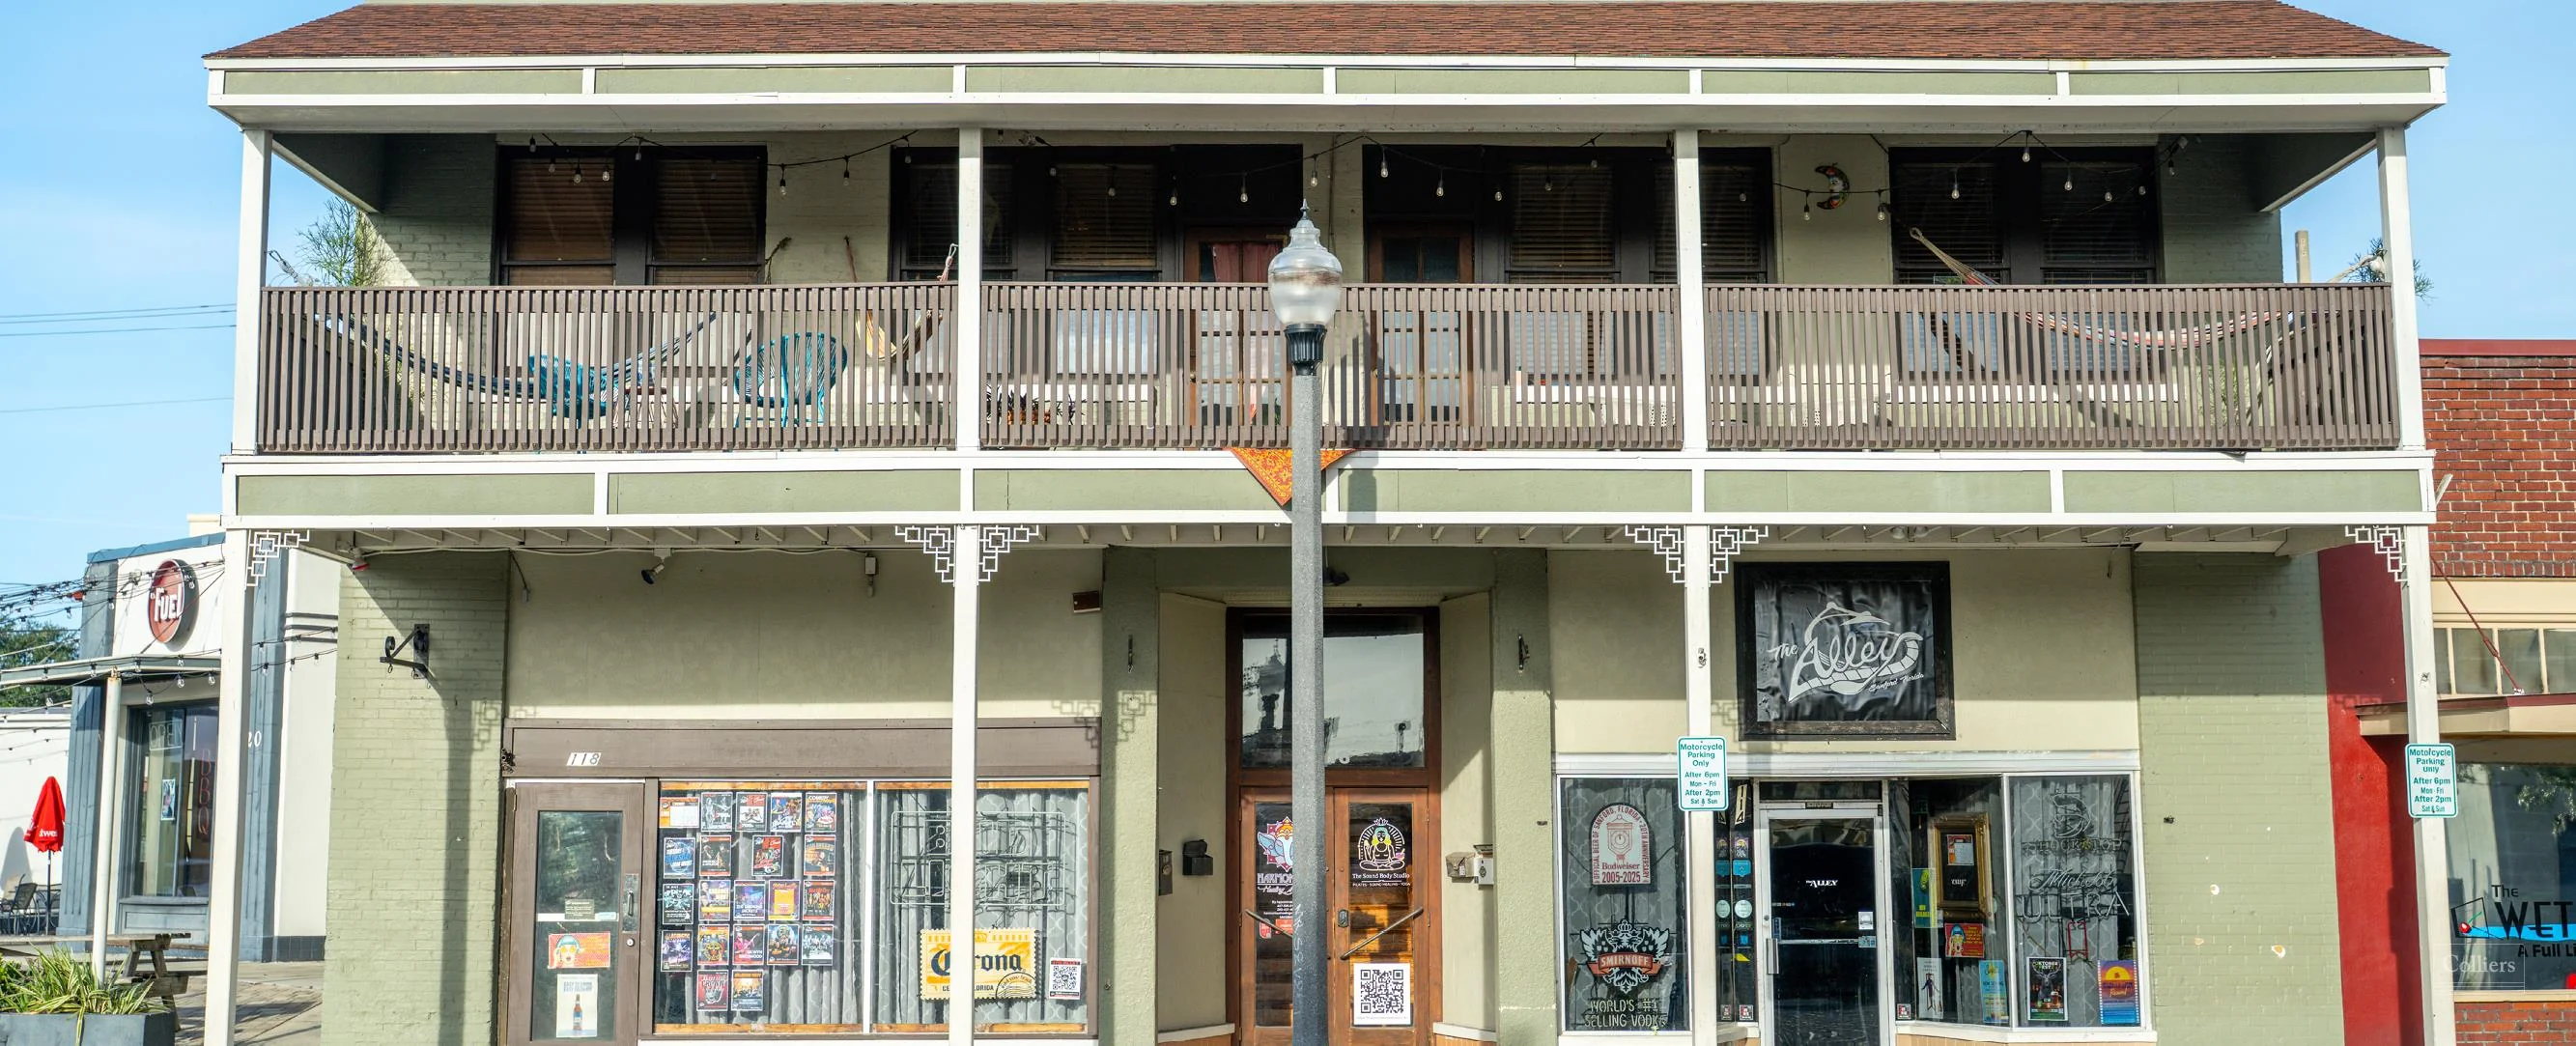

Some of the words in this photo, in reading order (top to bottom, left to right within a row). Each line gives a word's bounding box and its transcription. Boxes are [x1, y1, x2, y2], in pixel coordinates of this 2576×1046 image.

[1767, 642, 1798, 661] The
[1788, 632, 1923, 703] Alley
[571, 753, 600, 765] 118
[2434, 777, 2450, 785] 6pm
[2435, 795, 2452, 804] 2pm
[1602, 871, 1641, 883] 2005-2025
[2028, 869, 2116, 891] Michelob
[2491, 885, 2519, 897] The
[2022, 891, 2130, 920] ULTRA
[2494, 901, 2573, 941] WET
[2517, 945, 2529, 957] A
[2533, 944, 2561, 957] Full
[931, 948, 1022, 976] Cona
[1600, 955, 1649, 967] SMIRNOFF
[1591, 1000, 1635, 1012] WORLD'S
[1643, 999, 1658, 1012] #1
[1584, 1014, 1627, 1028] SELLING
